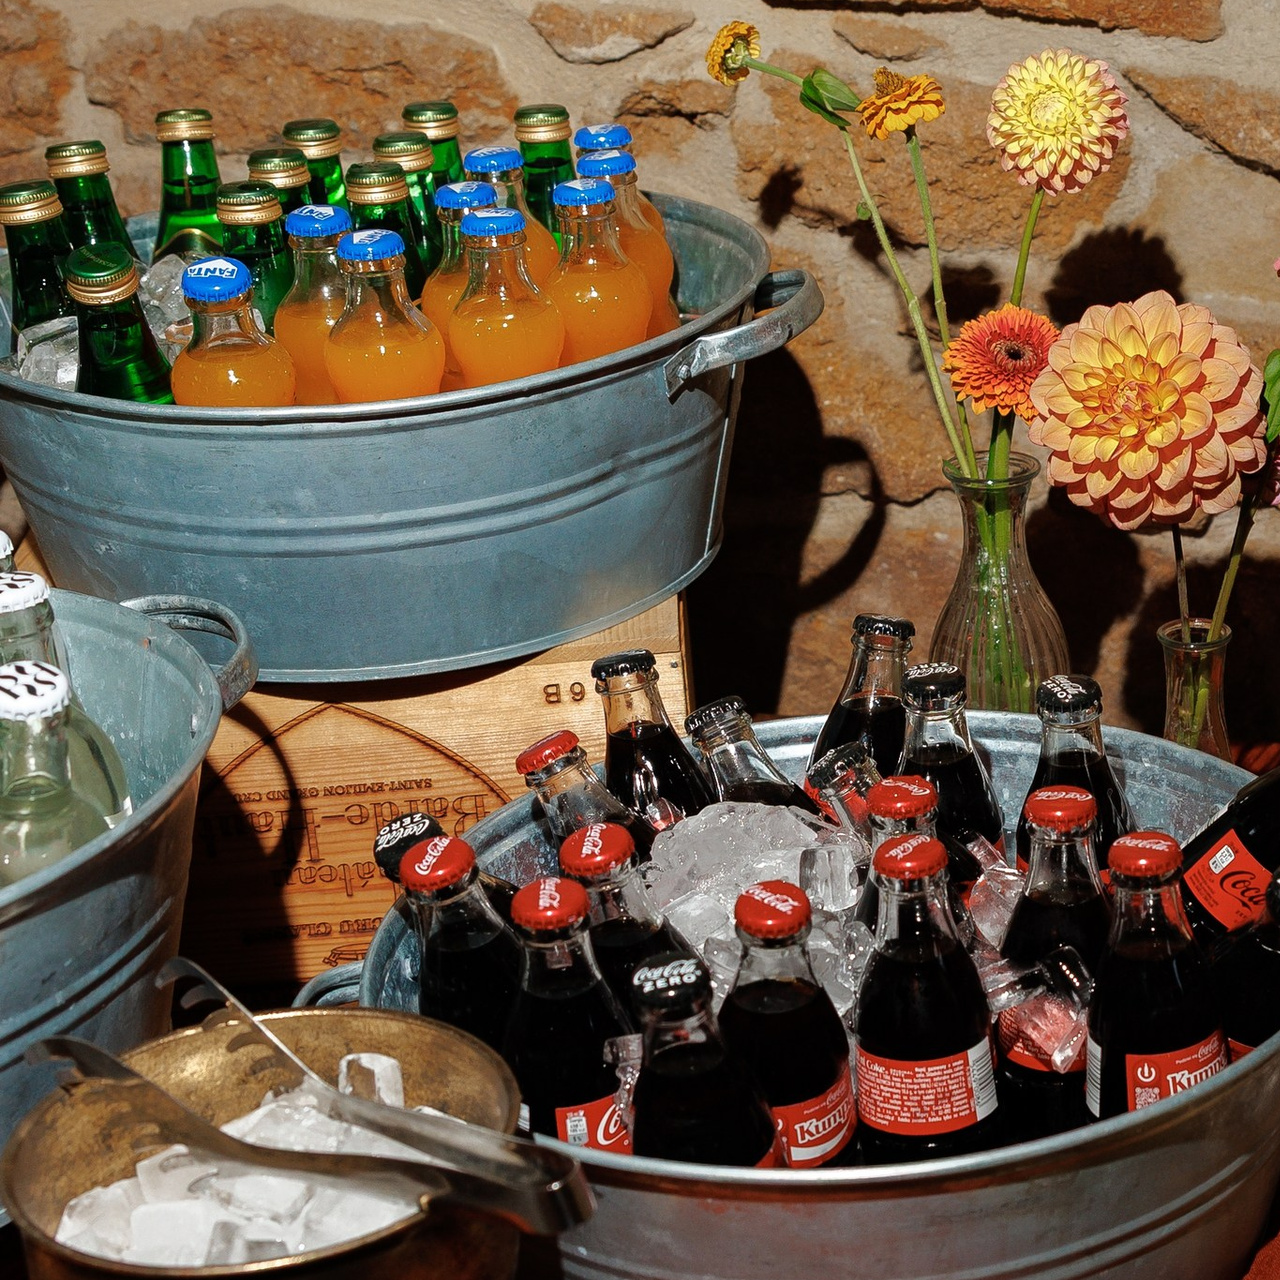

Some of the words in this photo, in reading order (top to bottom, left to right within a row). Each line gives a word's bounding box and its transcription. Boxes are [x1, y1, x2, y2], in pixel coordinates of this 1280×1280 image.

[188, 266, 238, 279] FANTA
[1041, 679, 1074, 700] ZERO
[324, 776, 433, 797] SAINT-EMILION
[233, 790, 264, 805] CRU
[379, 812, 424, 836] ZERO
[642, 973, 698, 994] ZERO
[866, 1059, 886, 1074] Coke
